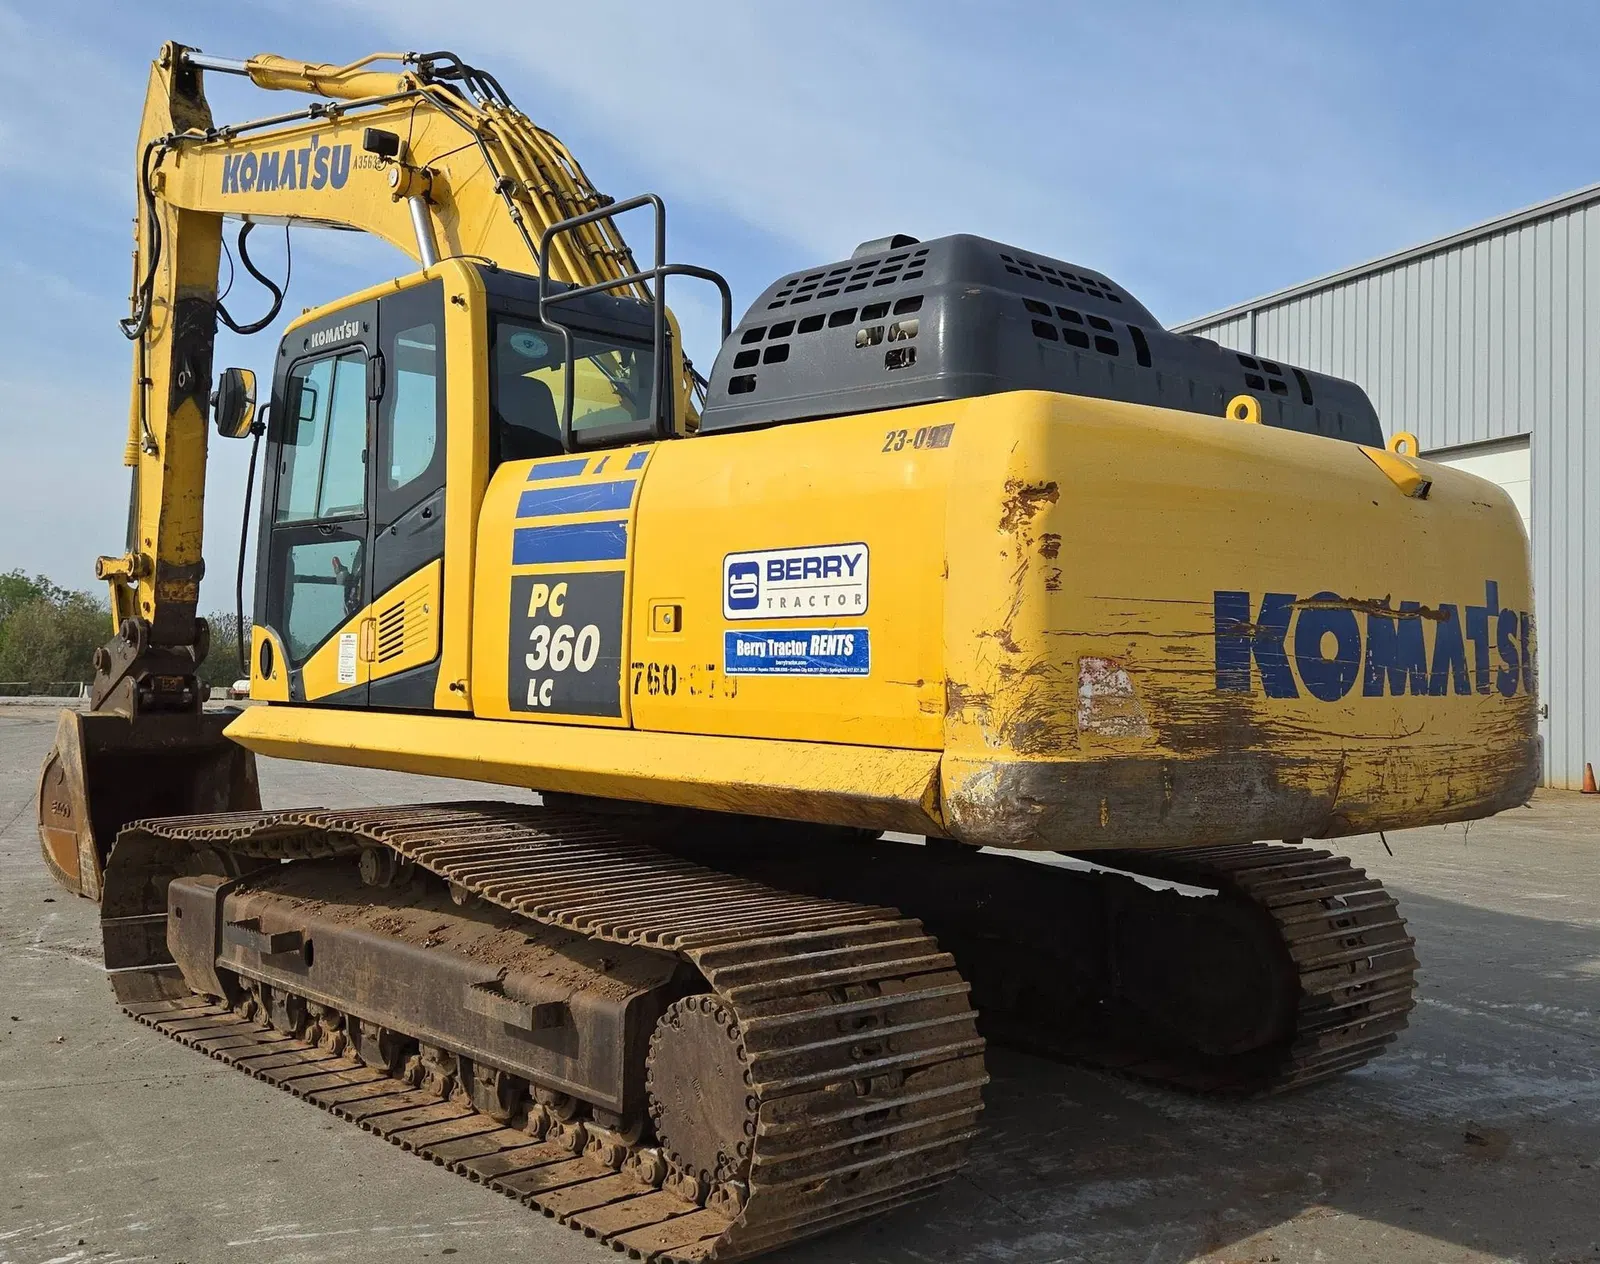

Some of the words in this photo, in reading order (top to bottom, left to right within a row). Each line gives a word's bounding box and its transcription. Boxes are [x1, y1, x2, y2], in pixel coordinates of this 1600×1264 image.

[221, 134, 352, 194] KOMATSU
[311, 320, 360, 348] KOMATSU
[767, 553, 862, 582] BERRY
[527, 582, 568, 618] PC
[767, 593, 862, 609] TRACTOR
[525, 624, 601, 673] 360
[736, 639, 766, 658] Berry
[767, 639, 808, 657] Tractor
[809, 634, 855, 656] RENTS
[527, 678, 554, 707] LC
